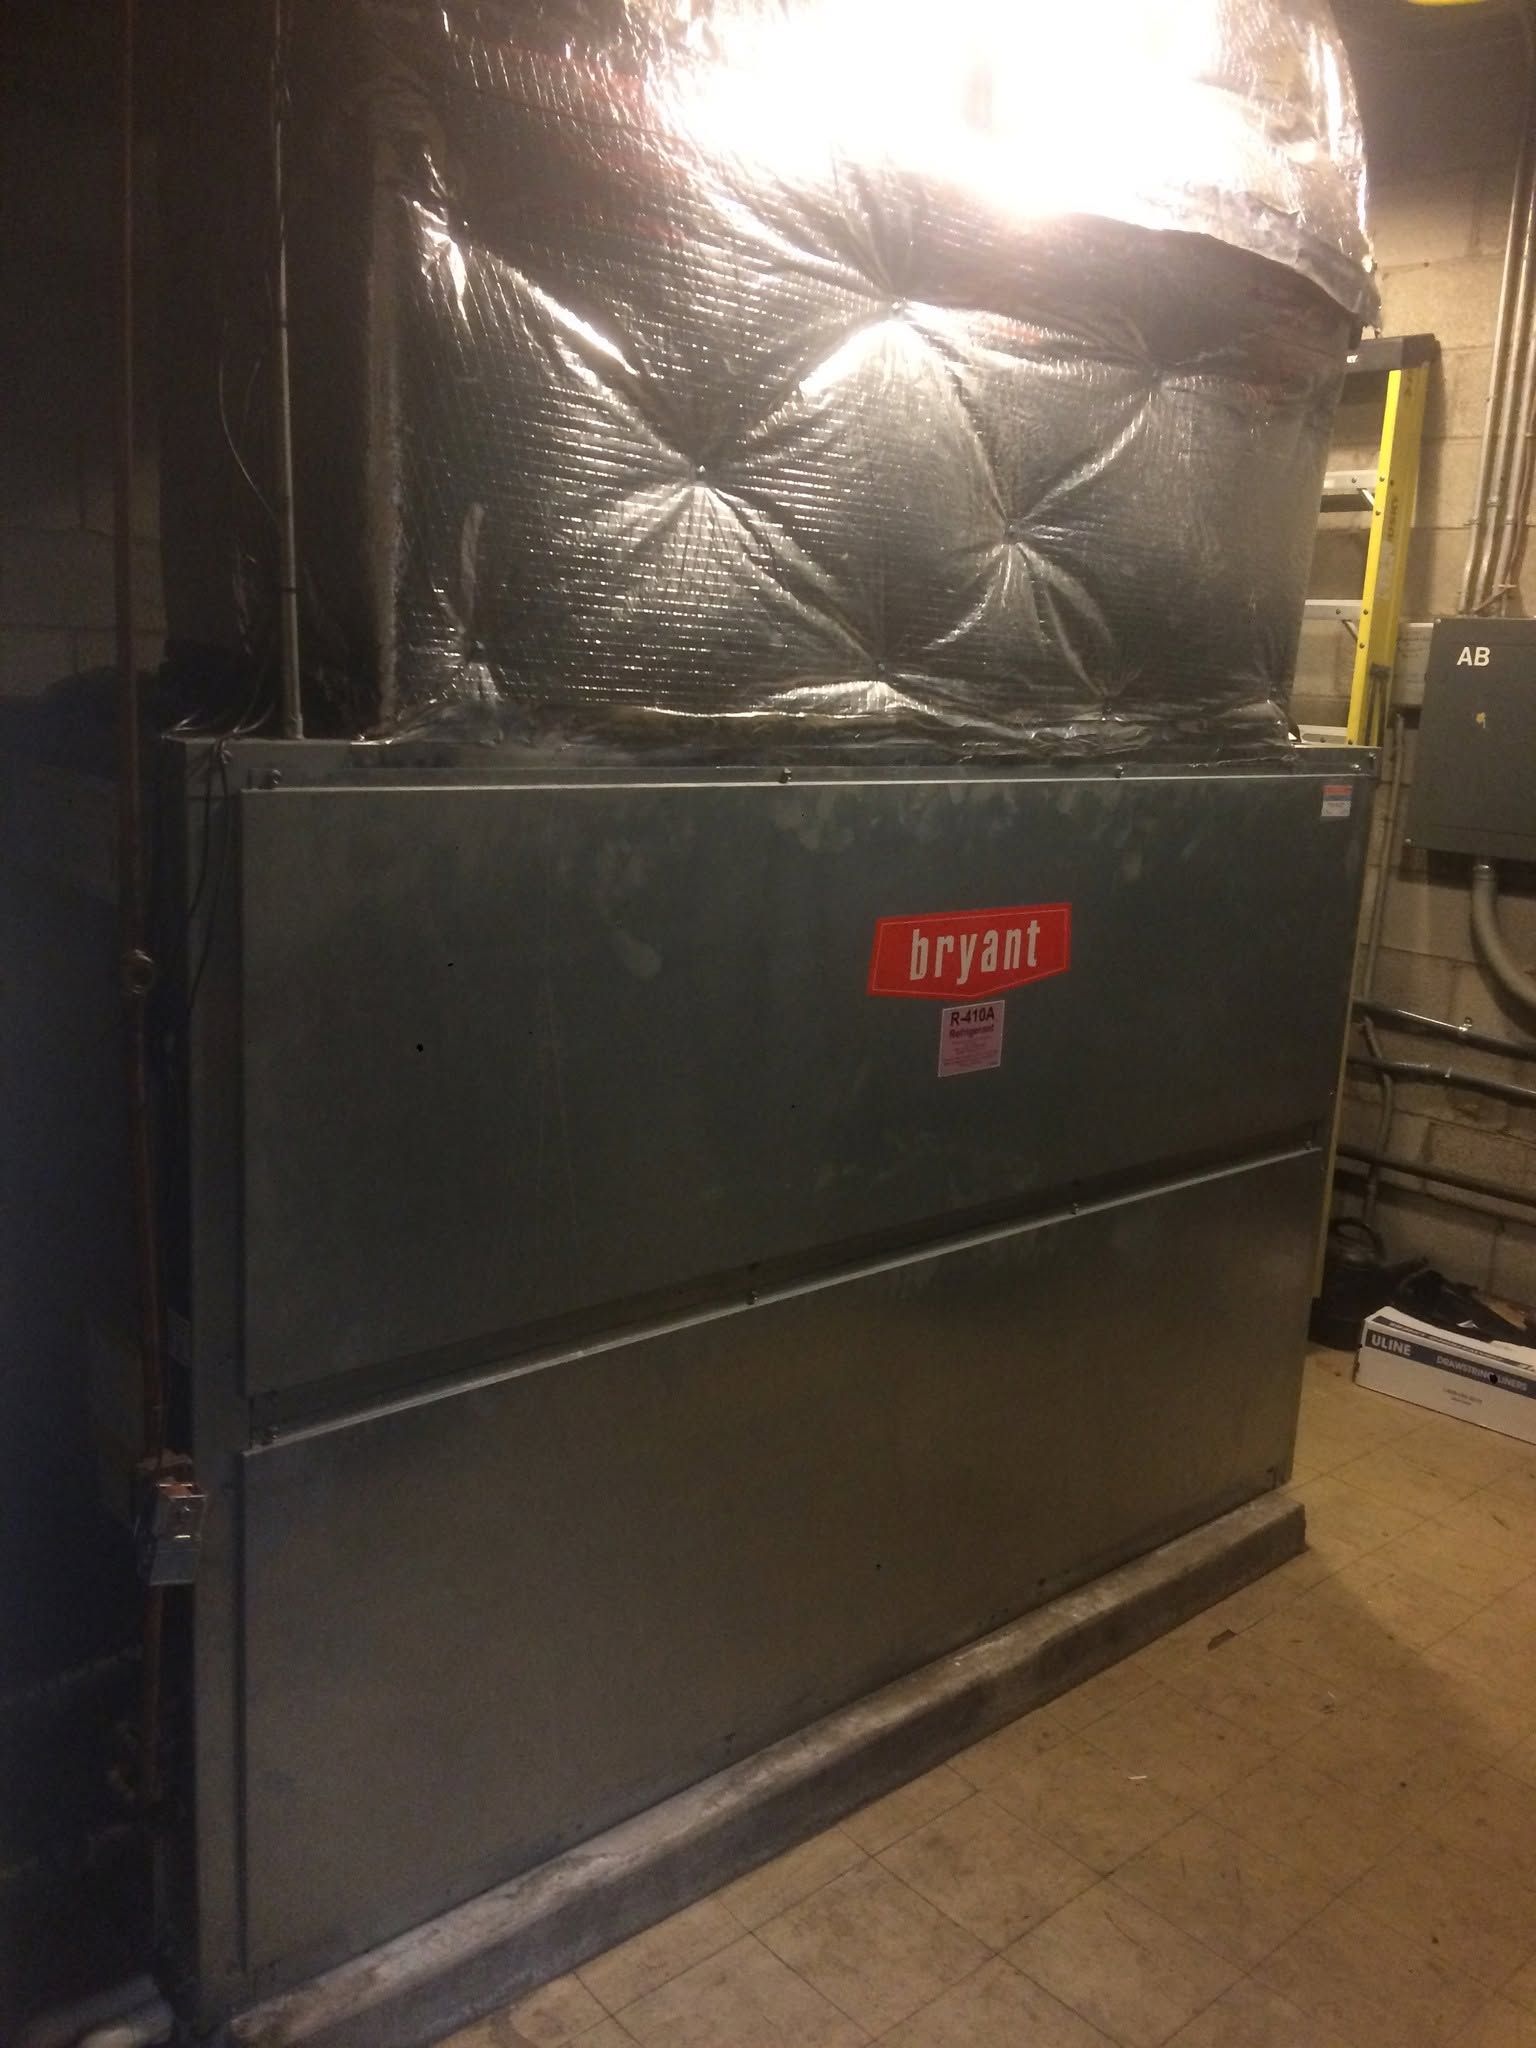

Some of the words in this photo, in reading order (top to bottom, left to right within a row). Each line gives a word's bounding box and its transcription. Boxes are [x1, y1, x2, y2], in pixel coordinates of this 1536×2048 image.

[1457, 646, 1491, 667] AB
[909, 919, 1041, 985] bryant
[950, 1006, 995, 1026] R-410A
[1371, 1333, 1412, 1357] ULINE
